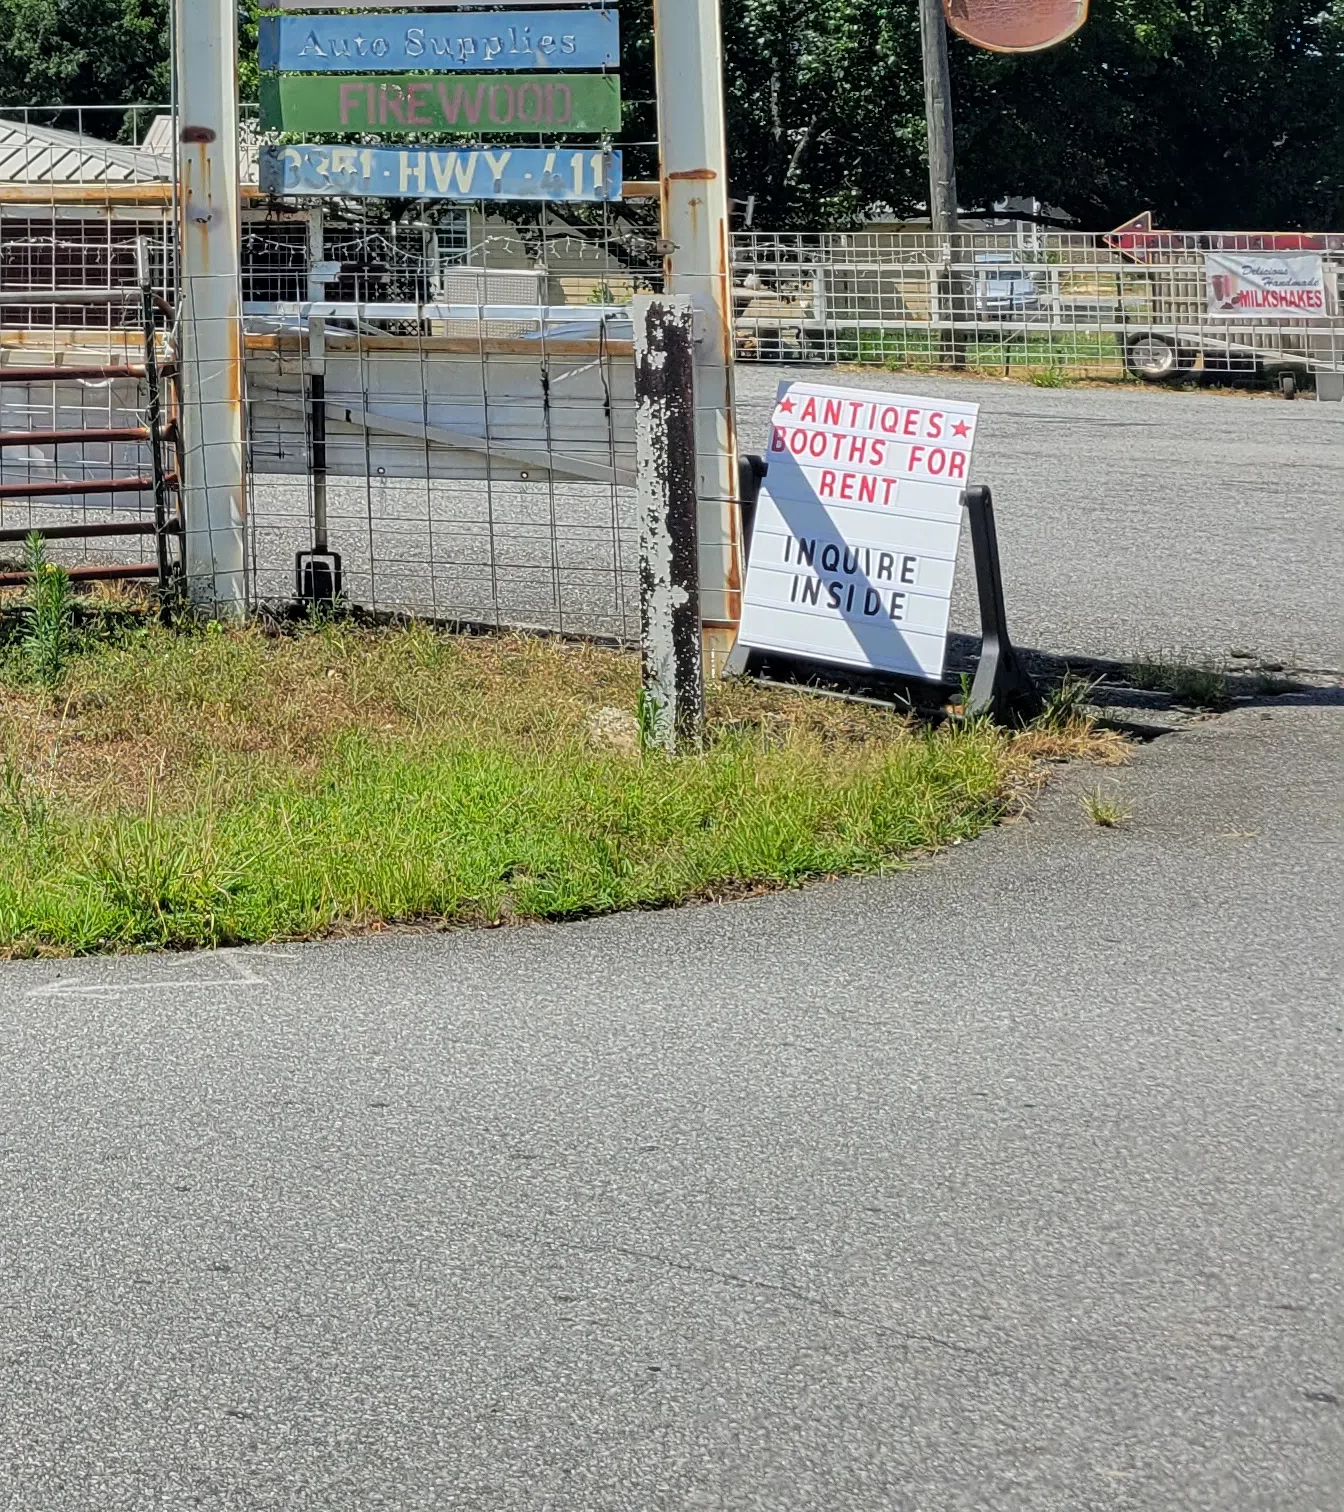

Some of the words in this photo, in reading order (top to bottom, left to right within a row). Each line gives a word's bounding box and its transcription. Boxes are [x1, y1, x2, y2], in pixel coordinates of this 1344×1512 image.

[297, 29, 390, 58] Auto
[403, 26, 577, 64] Supplies
[339, 82, 574, 125] FIREWOOD
[398, 150, 512, 194] HWY
[1241, 265, 1289, 276] Delicious
[1261, 276, 1320, 287] Handmade
[1239, 290, 1323, 308] MILKSHAKES
[800, 396, 944, 439] ANTIQES
[770, 425, 886, 466] BOOTHS
[907, 445, 967, 479] FOR
[819, 469, 897, 506] RENT
[783, 535, 918, 584] INQUIRE
[790, 574, 906, 621] INSIDE
